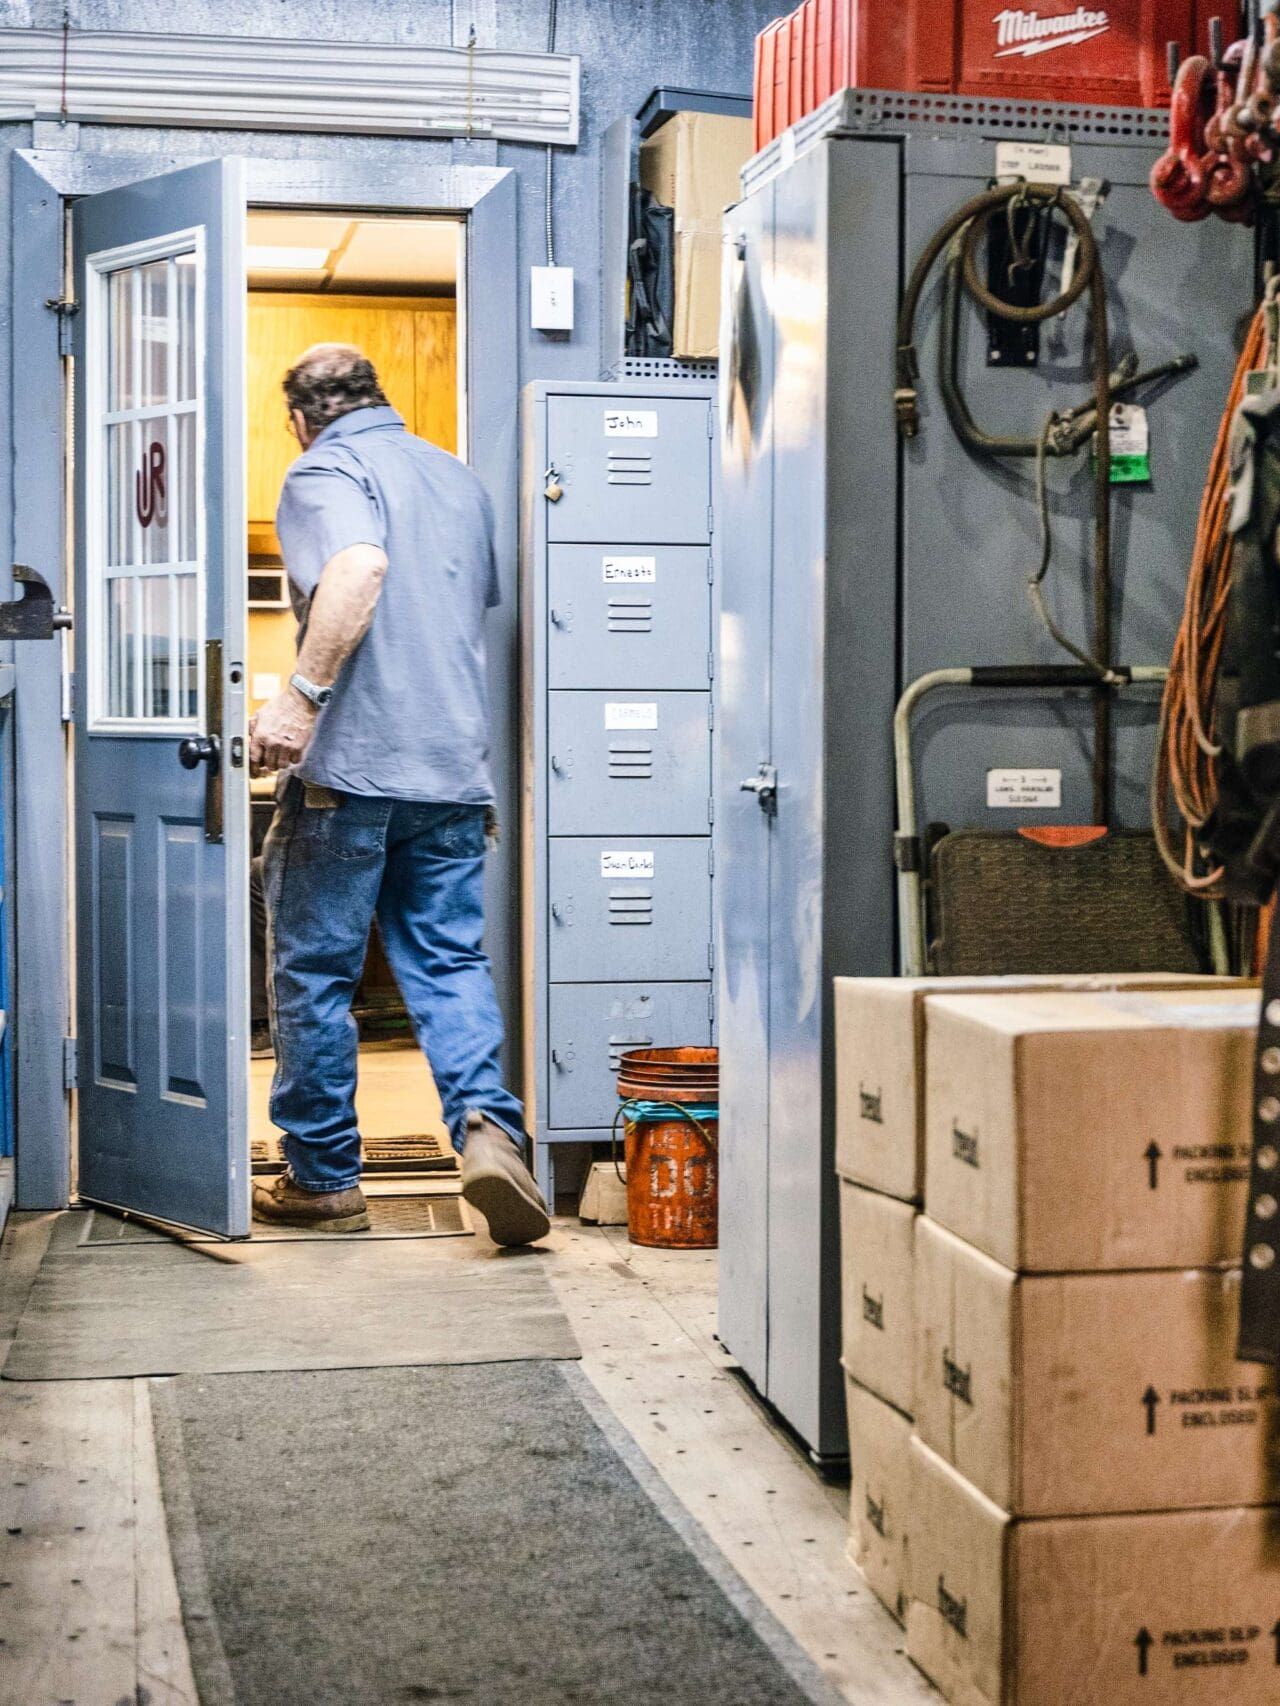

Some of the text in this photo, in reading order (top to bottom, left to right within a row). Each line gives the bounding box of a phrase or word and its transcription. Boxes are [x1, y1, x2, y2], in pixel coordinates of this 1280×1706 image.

[992, 6, 1110, 47] Milwaukee
[606, 416, 643, 429] John
[605, 564, 652, 578] Ernesto
[1172, 1143, 1234, 1159] PACKING
[649, 1154, 714, 1198] DO
[1184, 1166, 1249, 1183] ENCLOSE
[1170, 1387, 1232, 1404] PACKING
[1182, 1408, 1257, 1427] ENCLOSED
[1163, 1625, 1261, 1646] PACKING SLIP
[1173, 1649, 1249, 1669] ENCLOSED
